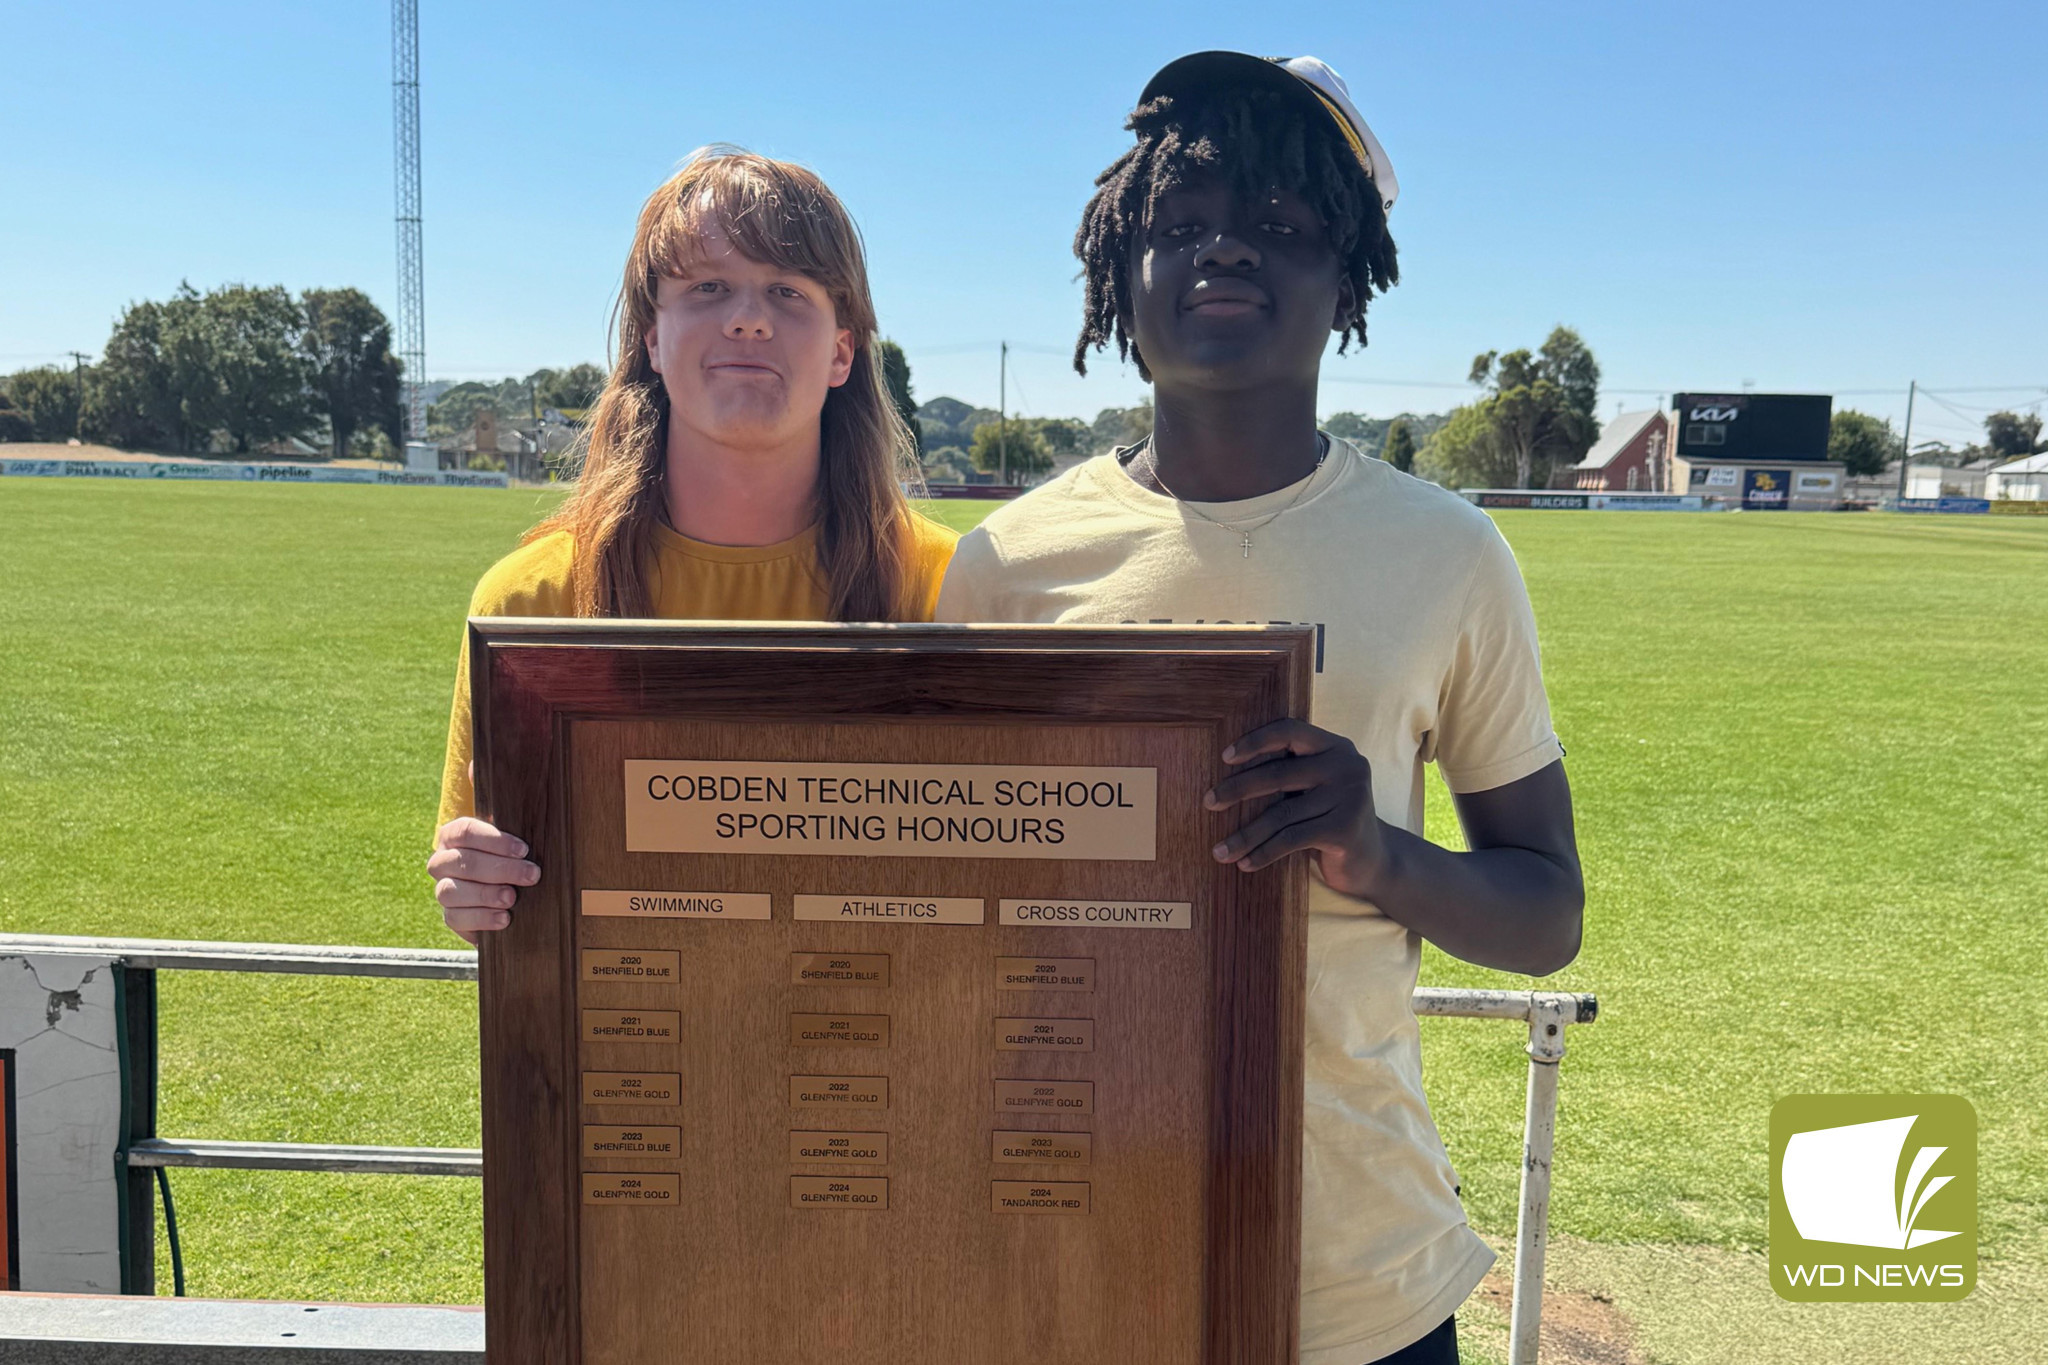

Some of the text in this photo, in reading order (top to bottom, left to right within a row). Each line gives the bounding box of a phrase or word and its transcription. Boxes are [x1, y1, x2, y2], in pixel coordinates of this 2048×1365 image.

[1690, 407, 1739, 421] KIA
[260, 467, 312, 479] pipeline
[1531, 496, 1583, 508] BUILDERS
[647, 774, 1134, 809] COBDEN TECHNICAL SCHOOL
[715, 812, 1065, 844] SPORTING HONOURS
[629, 896, 724, 913] SWIMMING
[840, 901, 938, 918] ATHLETICS
[1016, 904, 1174, 924] CROSS COUNTRY
[621, 957, 641, 965] 2020
[830, 961, 851, 969] 2020
[592, 966, 670, 976] SHENFIELD BLUE
[1035, 965, 1056, 973] 2020
[801, 971, 879, 980] SHENFIELD BLUE
[1006, 975, 1085, 985] SHENFIELD BLUE
[621, 1017, 641, 1025] 2021
[830, 1021, 850, 1029] 2021
[593, 1027, 670, 1037] SHENFIELD BLUE
[1034, 1025, 1054, 1034] 2021
[801, 1031, 879, 1041] GLENFYNE GOLD
[1005, 1035, 1084, 1045] GLENFYNE GOLD
[621, 1079, 642, 1087] 2022
[829, 1083, 849, 1091] 2022
[593, 1089, 670, 1099] GLENFYNE GOLD
[1034, 1088, 1054, 1096] 2022
[800, 1093, 878, 1103] GLENFYNE GOLD
[1005, 1098, 1083, 1107] GLENFYNE GOLD
[594, 1143, 671, 1152] SHENFIELD BLUE
[1031, 1139, 1052, 1147] 2023
[800, 1149, 878, 1158] GLENFYNE GOLD
[1003, 1149, 1081, 1158] GLENFYNE GOLD
[621, 1180, 641, 1188] 2024
[829, 1184, 850, 1192] 2024
[593, 1190, 669, 1199] GLENFYNE GOLD
[1030, 1189, 1051, 1197] 2024
[801, 1194, 878, 1203] GLENFYNE GOLD
[1001, 1199, 1080, 1208] TANDAROOK RED
